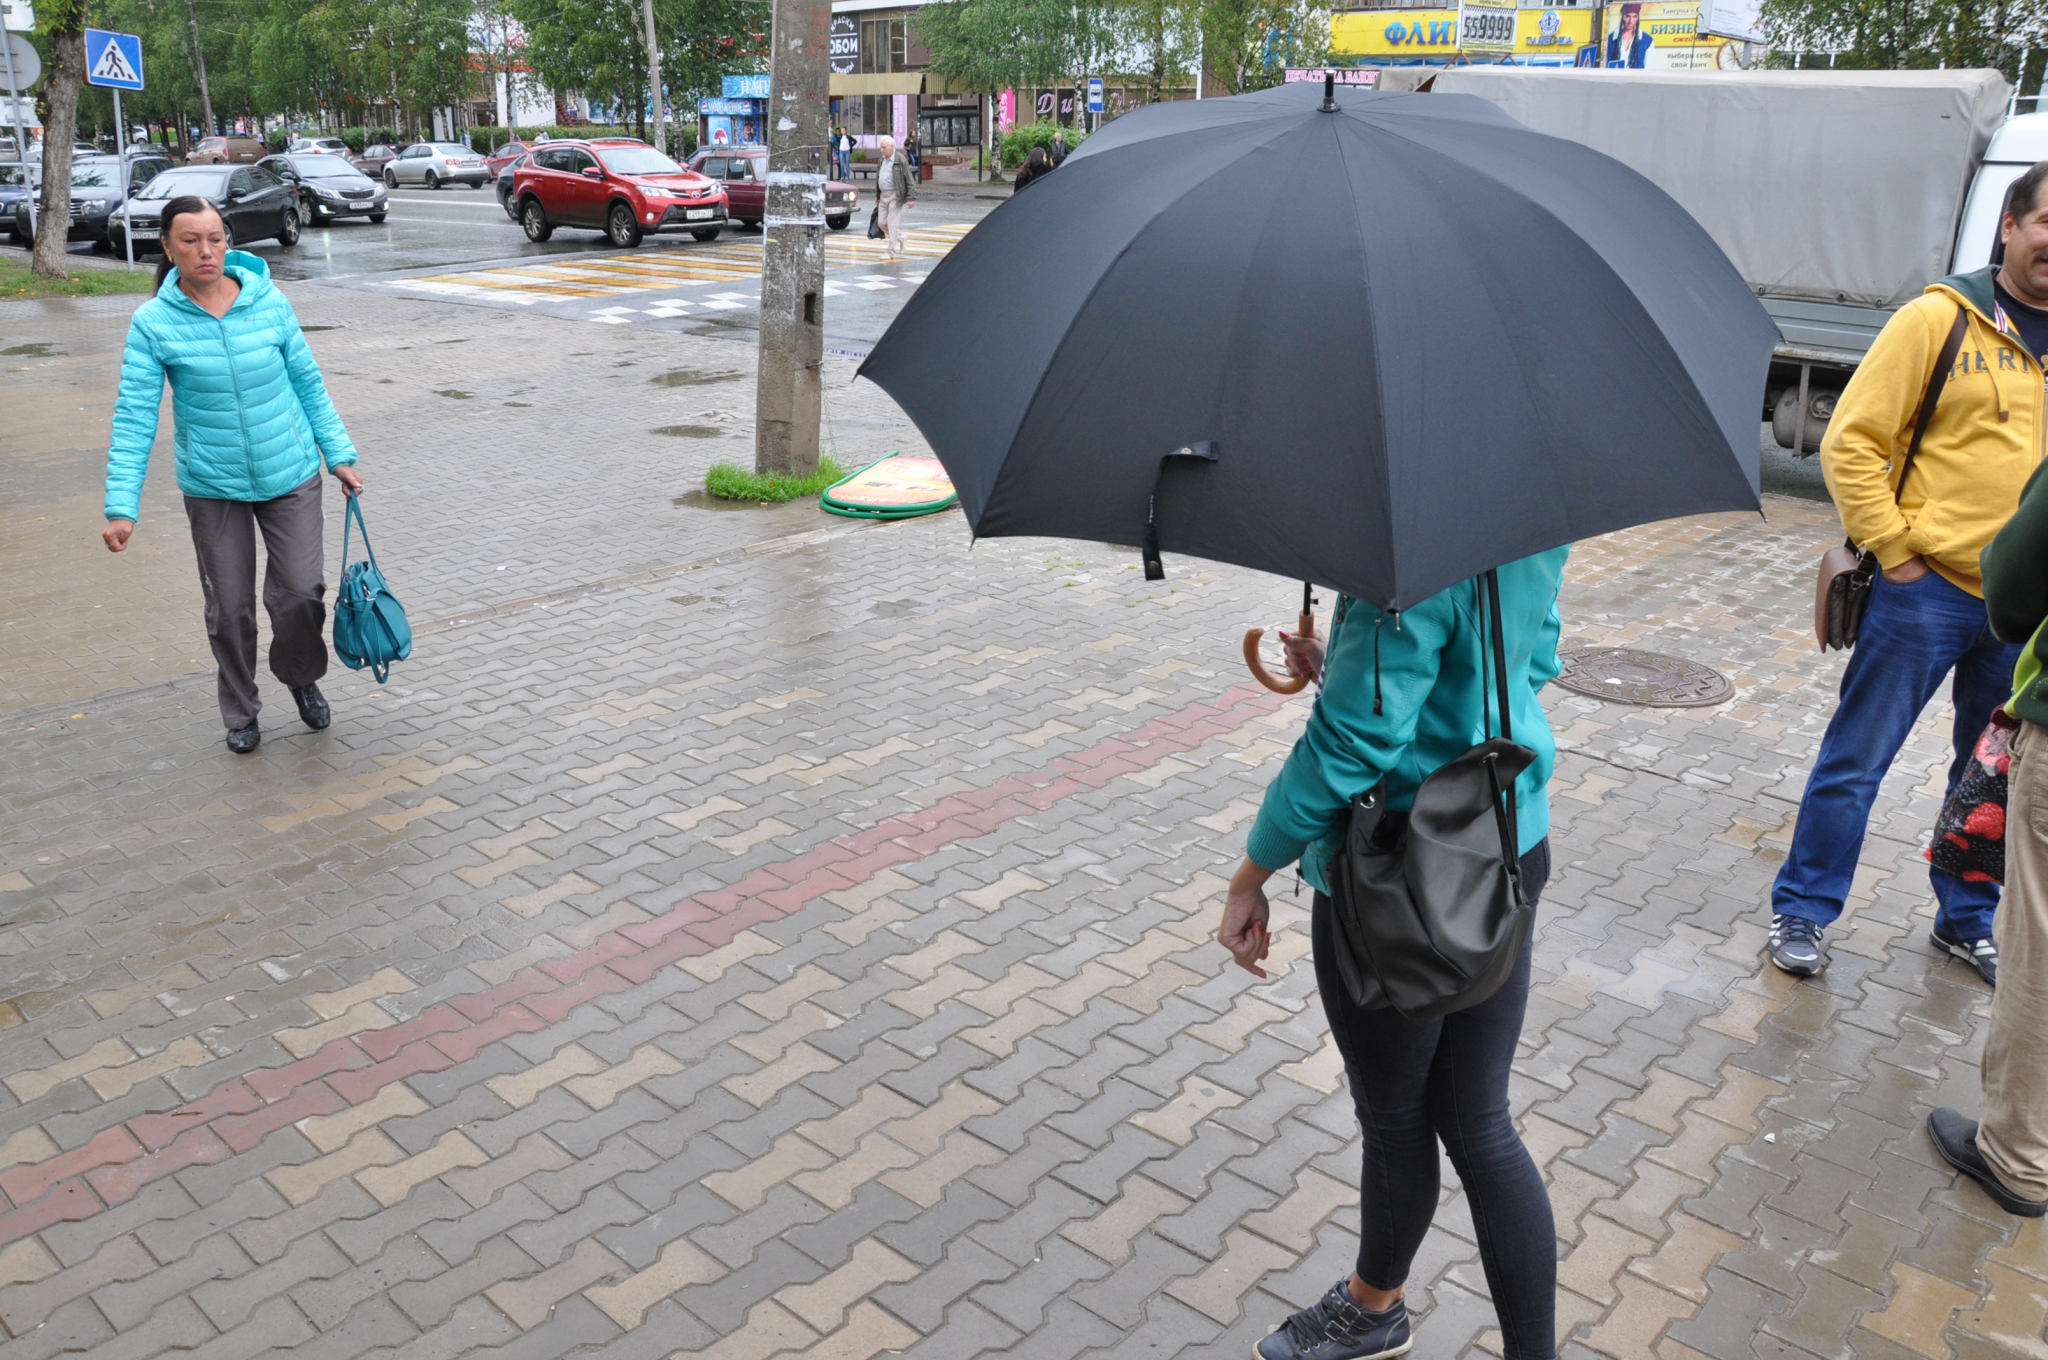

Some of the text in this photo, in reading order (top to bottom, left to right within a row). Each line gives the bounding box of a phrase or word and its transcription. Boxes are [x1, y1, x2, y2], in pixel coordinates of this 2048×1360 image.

[1384, 21, 1458, 45] ФЛИ
[1463, 14, 1513, 42] 559999
[830, 37, 858, 54] ОБОИ
[1285, 70, 1326, 82] ПЕЧАТЬ
[1345, 71, 1380, 84] БАНН
[741, 80, 770, 94] НАП
